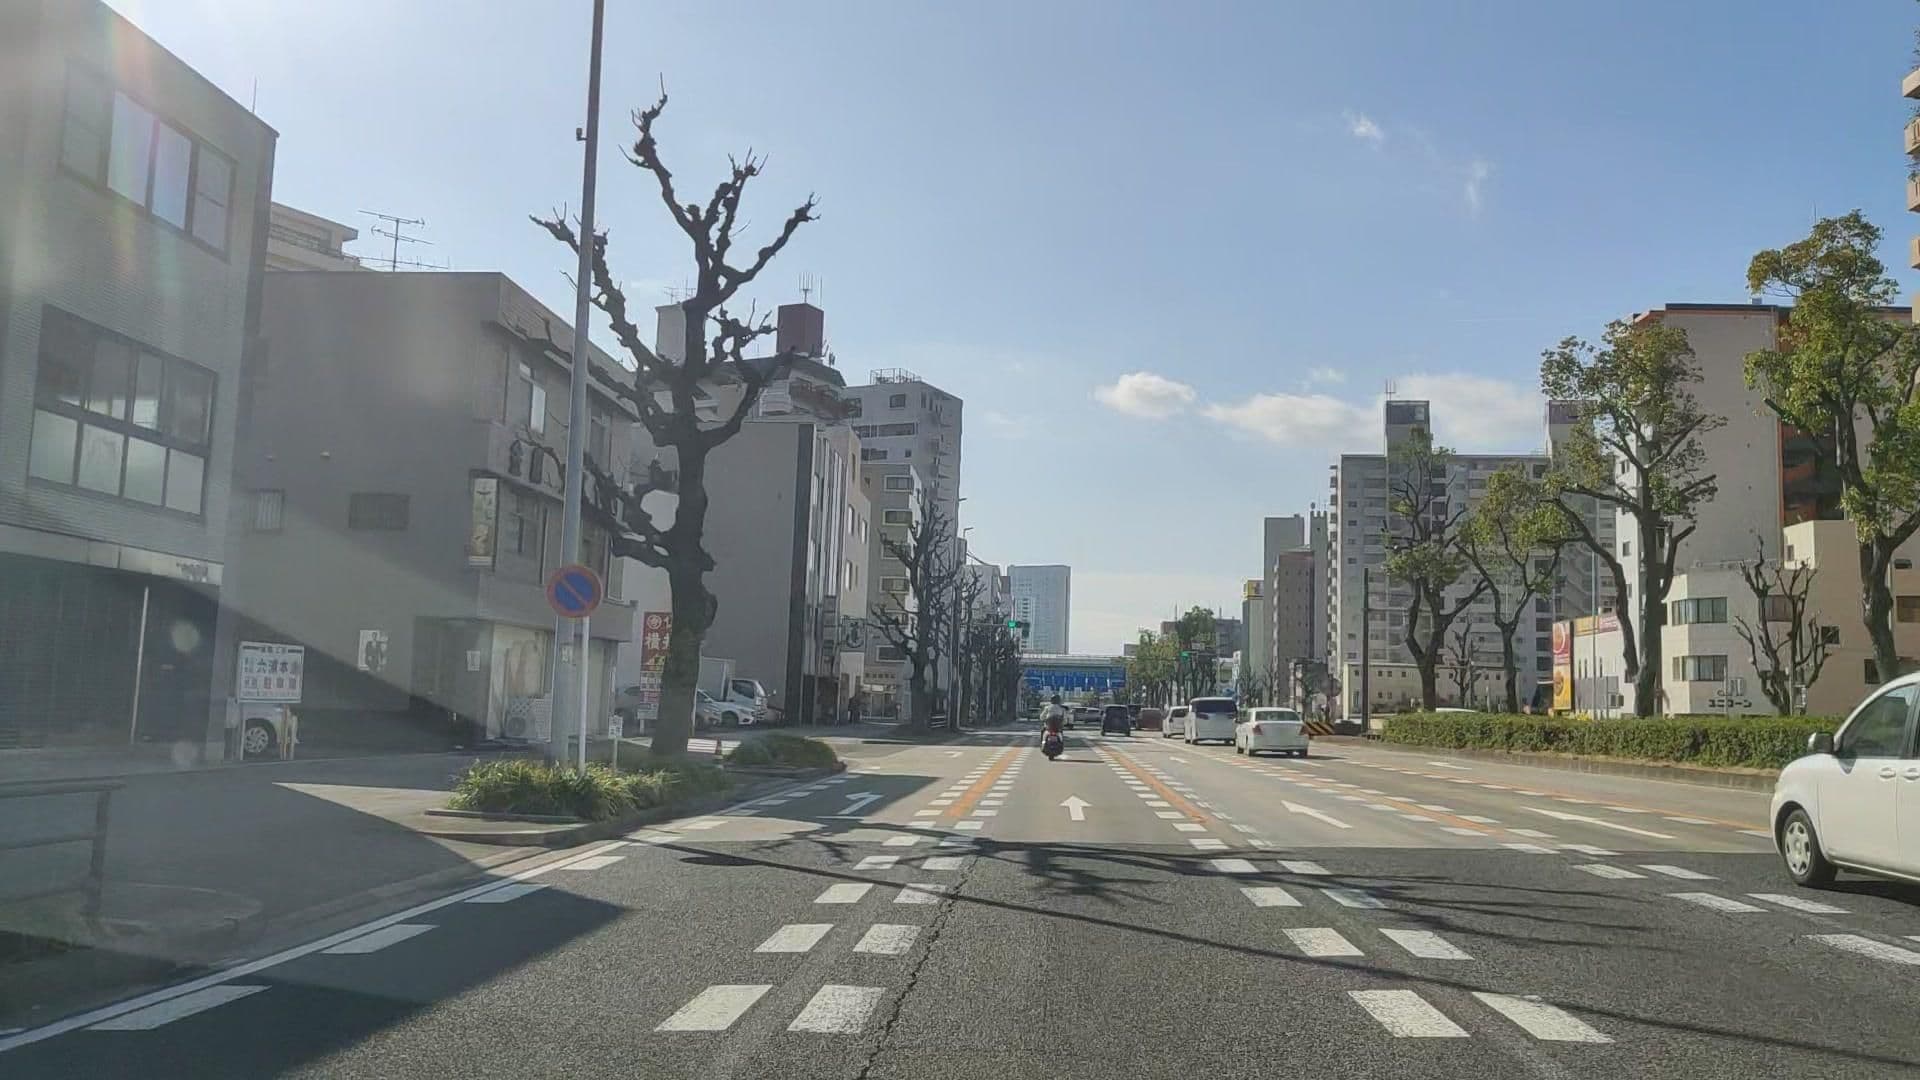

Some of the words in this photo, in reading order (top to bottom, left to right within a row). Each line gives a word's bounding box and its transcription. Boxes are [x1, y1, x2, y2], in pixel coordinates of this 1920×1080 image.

[1708, 699, 1753, 708] ユニコーン
